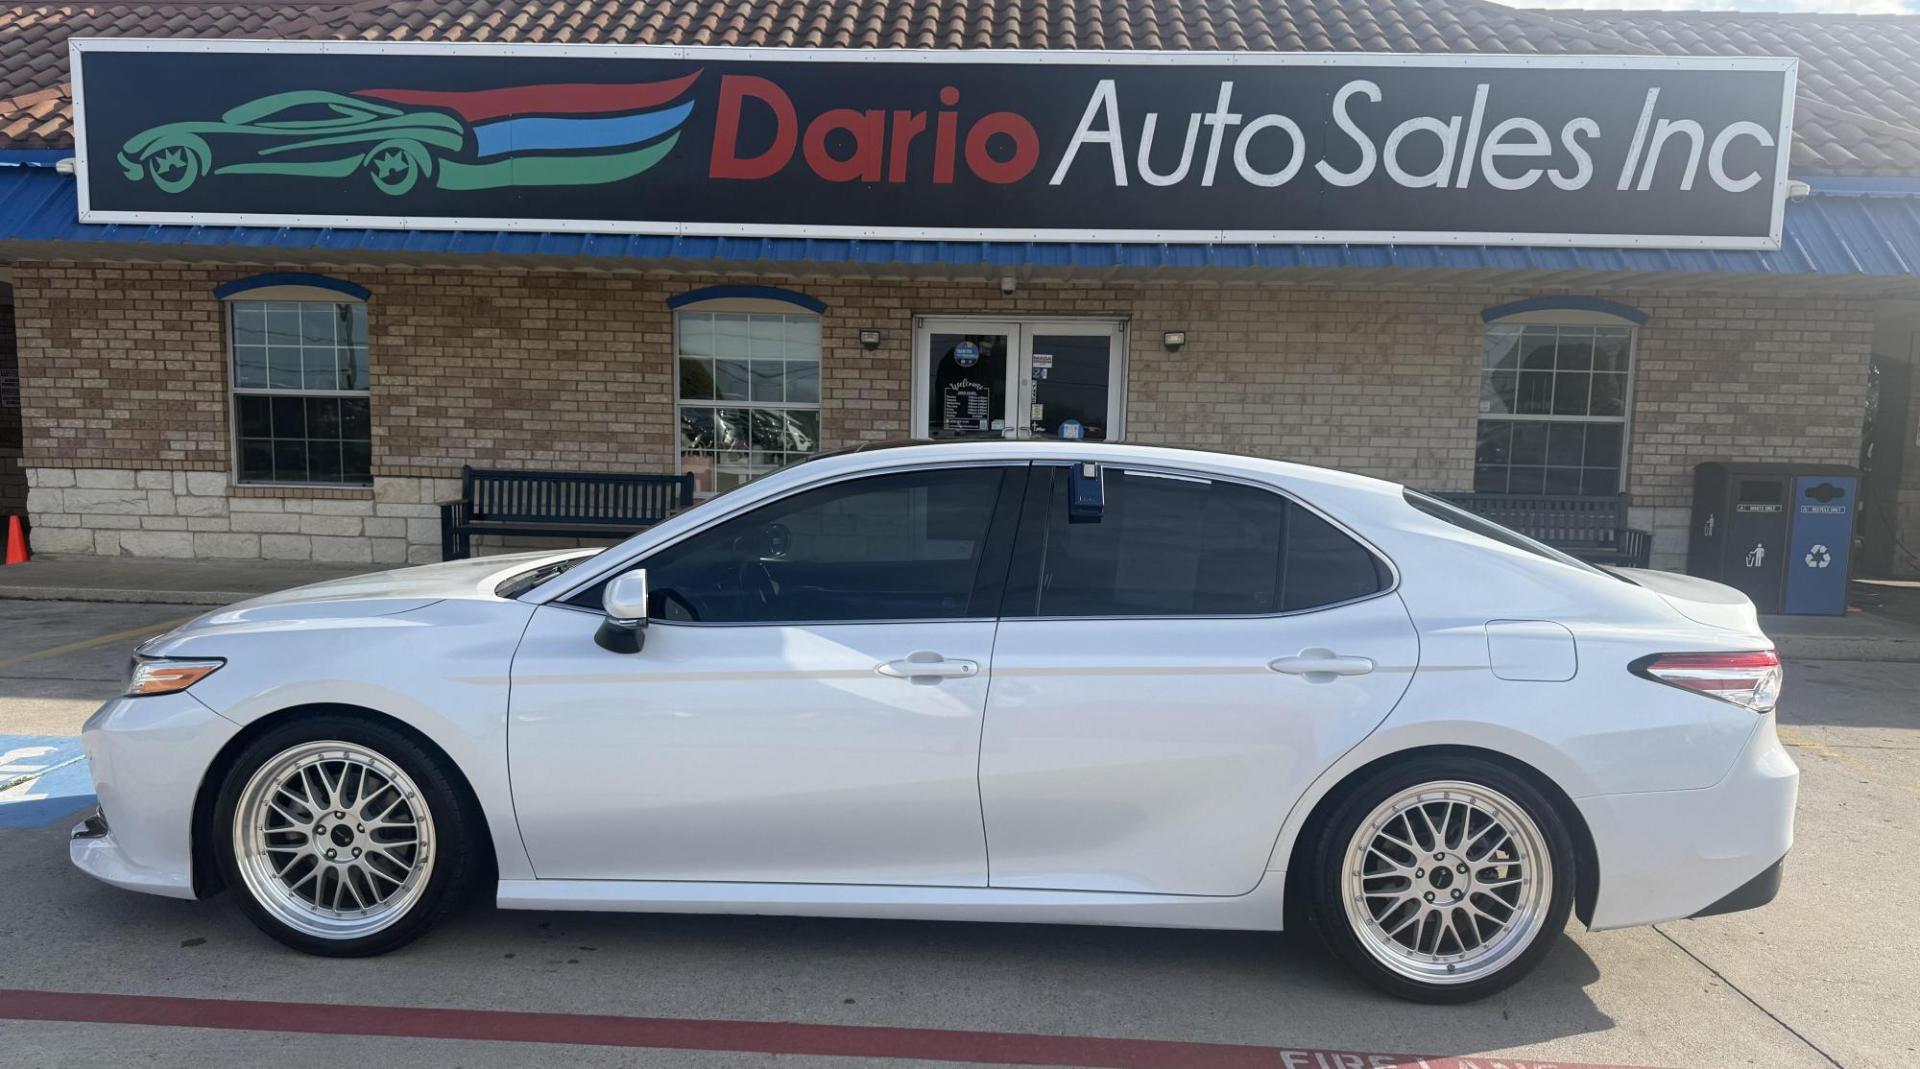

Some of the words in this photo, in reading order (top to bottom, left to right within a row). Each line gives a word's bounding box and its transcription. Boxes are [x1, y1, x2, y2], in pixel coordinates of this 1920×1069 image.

[709, 74, 1040, 185] Dario
[1048, 79, 1305, 188] Auto
[1314, 79, 1601, 191] Sales
[1616, 87, 1775, 193] Inc
[949, 378, 984, 391] Welcome
